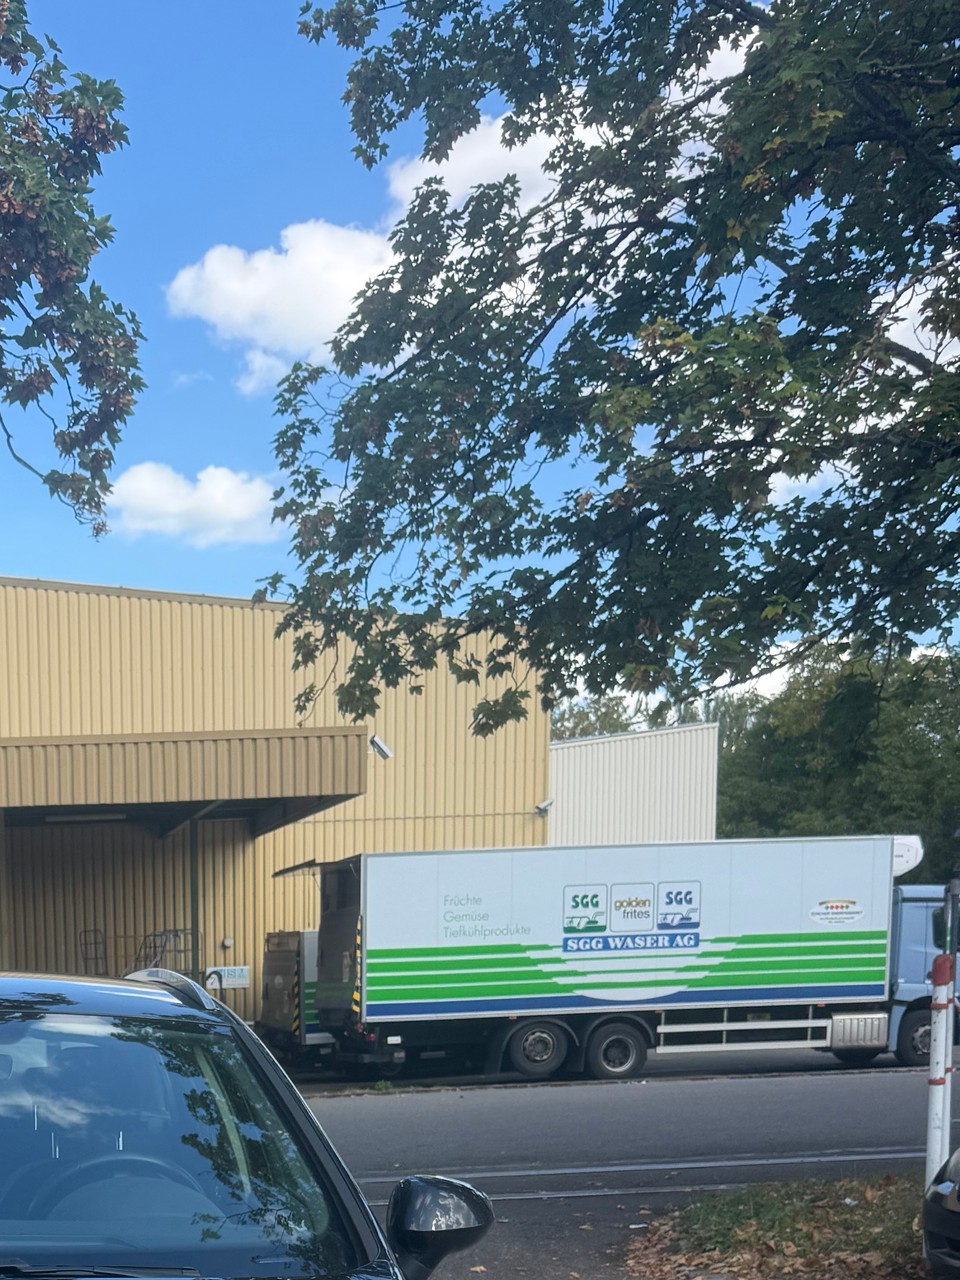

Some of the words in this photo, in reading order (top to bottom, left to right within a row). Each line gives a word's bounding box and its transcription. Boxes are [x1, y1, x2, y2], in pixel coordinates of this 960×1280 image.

[443, 895, 483, 907] Früchte
[571, 894, 600, 909] SGG
[614, 897, 651, 910] golden
[665, 890, 693, 905] SGG
[443, 911, 489, 922] Gemüse
[622, 908, 650, 919] frites
[443, 925, 531, 939] Tiefkühlprodukte
[567, 938, 603, 950] SGG
[607, 936, 670, 949] WASER
[673, 934, 695, 947] AG
